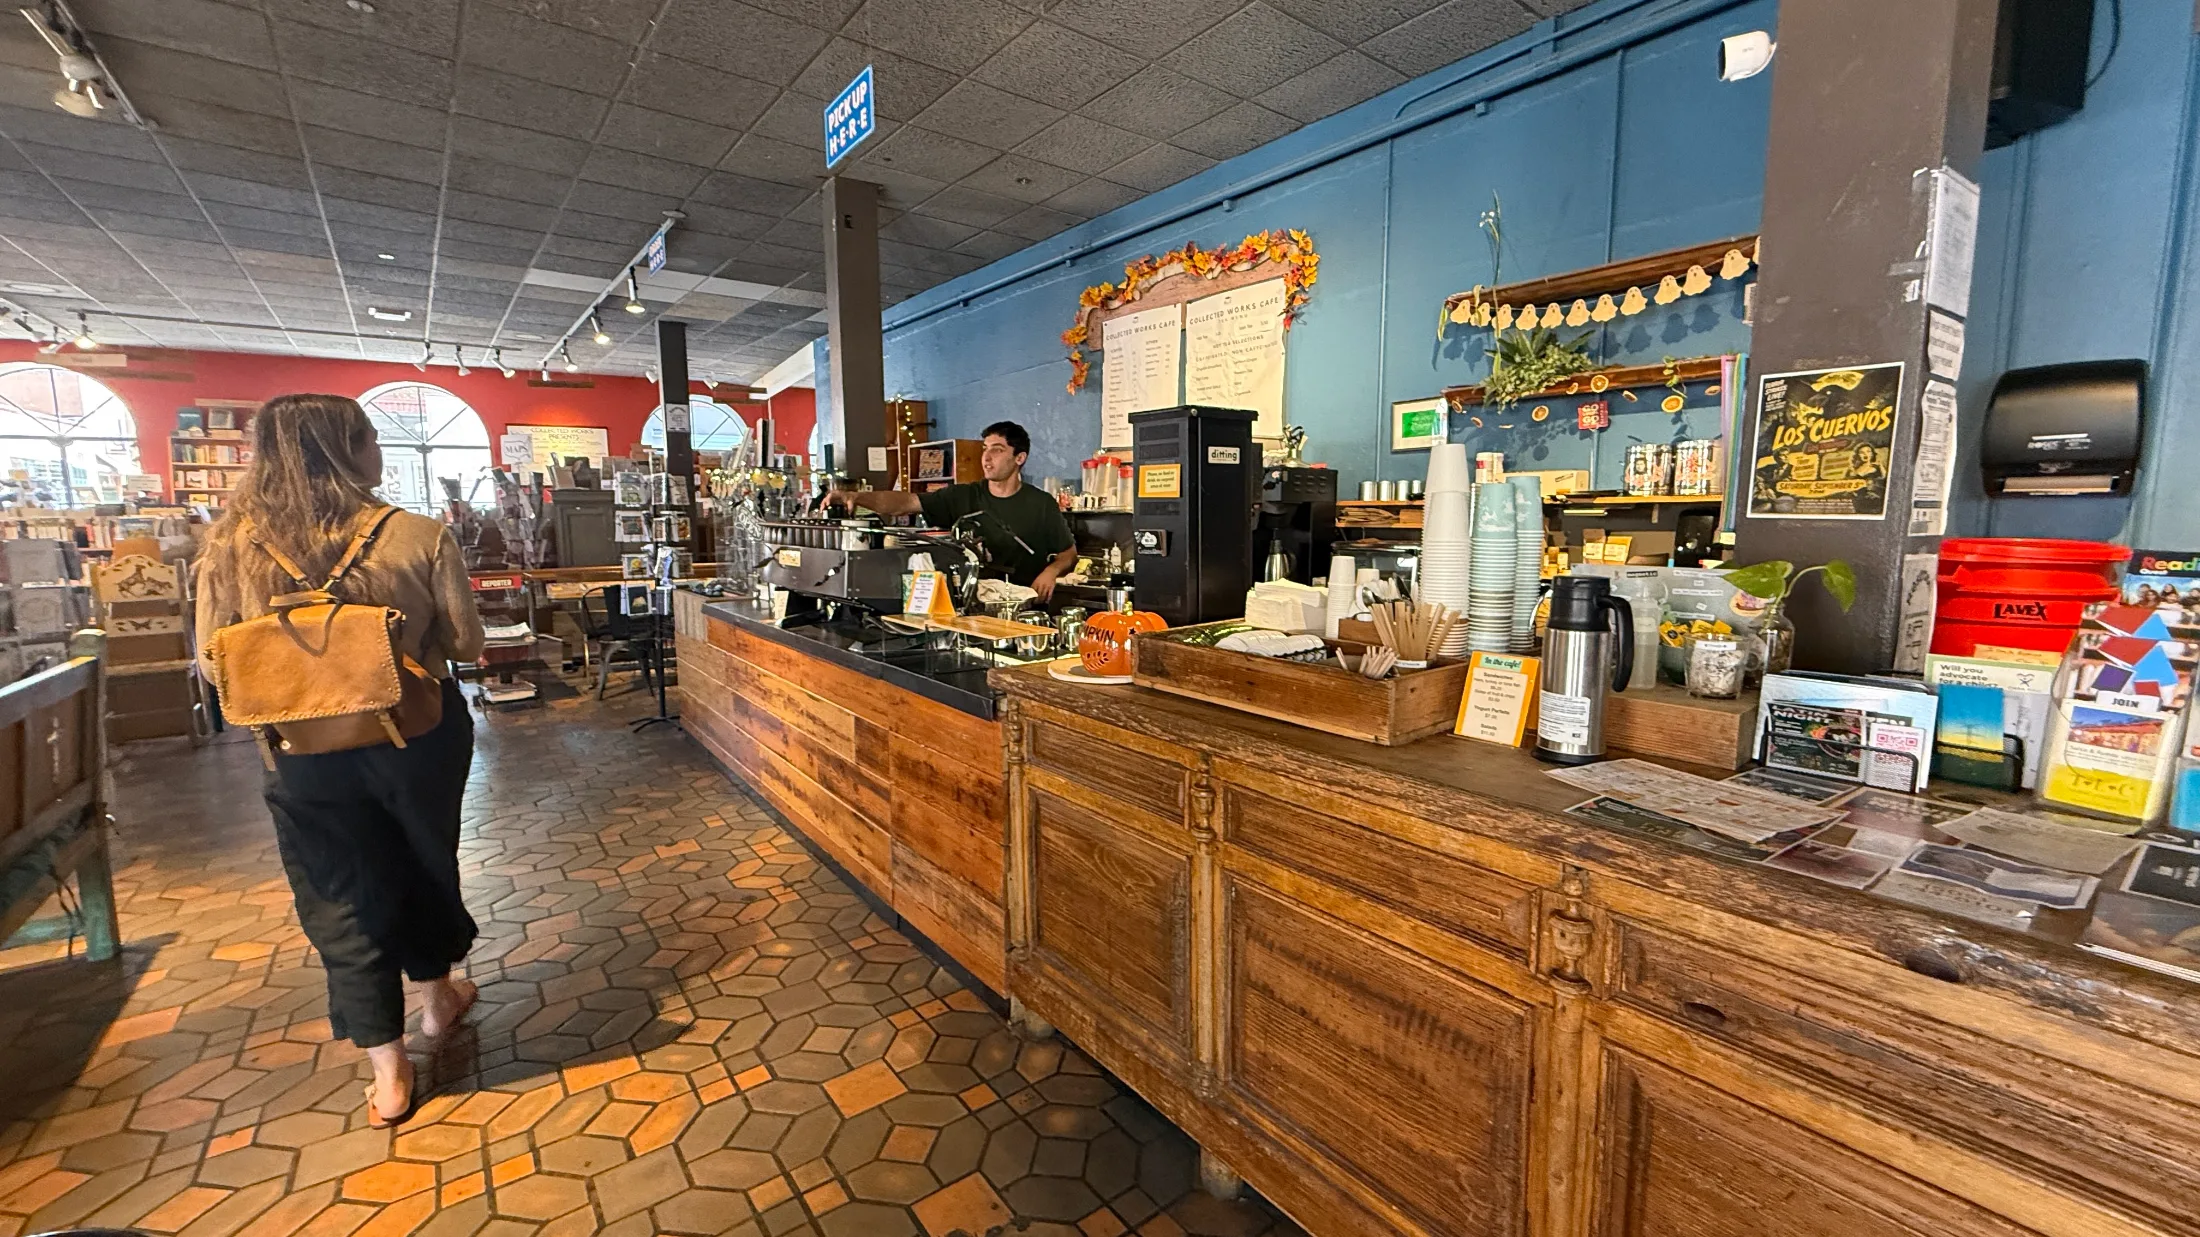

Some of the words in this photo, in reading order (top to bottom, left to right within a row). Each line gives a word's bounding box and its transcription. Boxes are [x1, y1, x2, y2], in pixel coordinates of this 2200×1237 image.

[828, 94, 852, 133] PICK
[851, 81, 867, 109] UP
[1190, 311, 1224, 325] COLLECTED
[1227, 302, 1257, 315] WORKS
[1260, 297, 1279, 308] CAFE
[1106, 329, 1133, 341] COLLECTED
[1134, 324, 1157, 334] WORKS
[1159, 320, 1176, 328] CAFE
[1772, 425, 1807, 451] LOS
[1809, 405, 1893, 442] CUERVOS
[1211, 449, 1238, 461] ditting
[481, 579, 512, 588] REPORTER
[1940, 664, 1961, 672] Will
[1940, 672, 1988, 681] advocate
[2111, 698, 2140, 708] JOIN
[1772, 705, 1829, 718] LATIN
[1773, 710, 1834, 724] NIGHT
